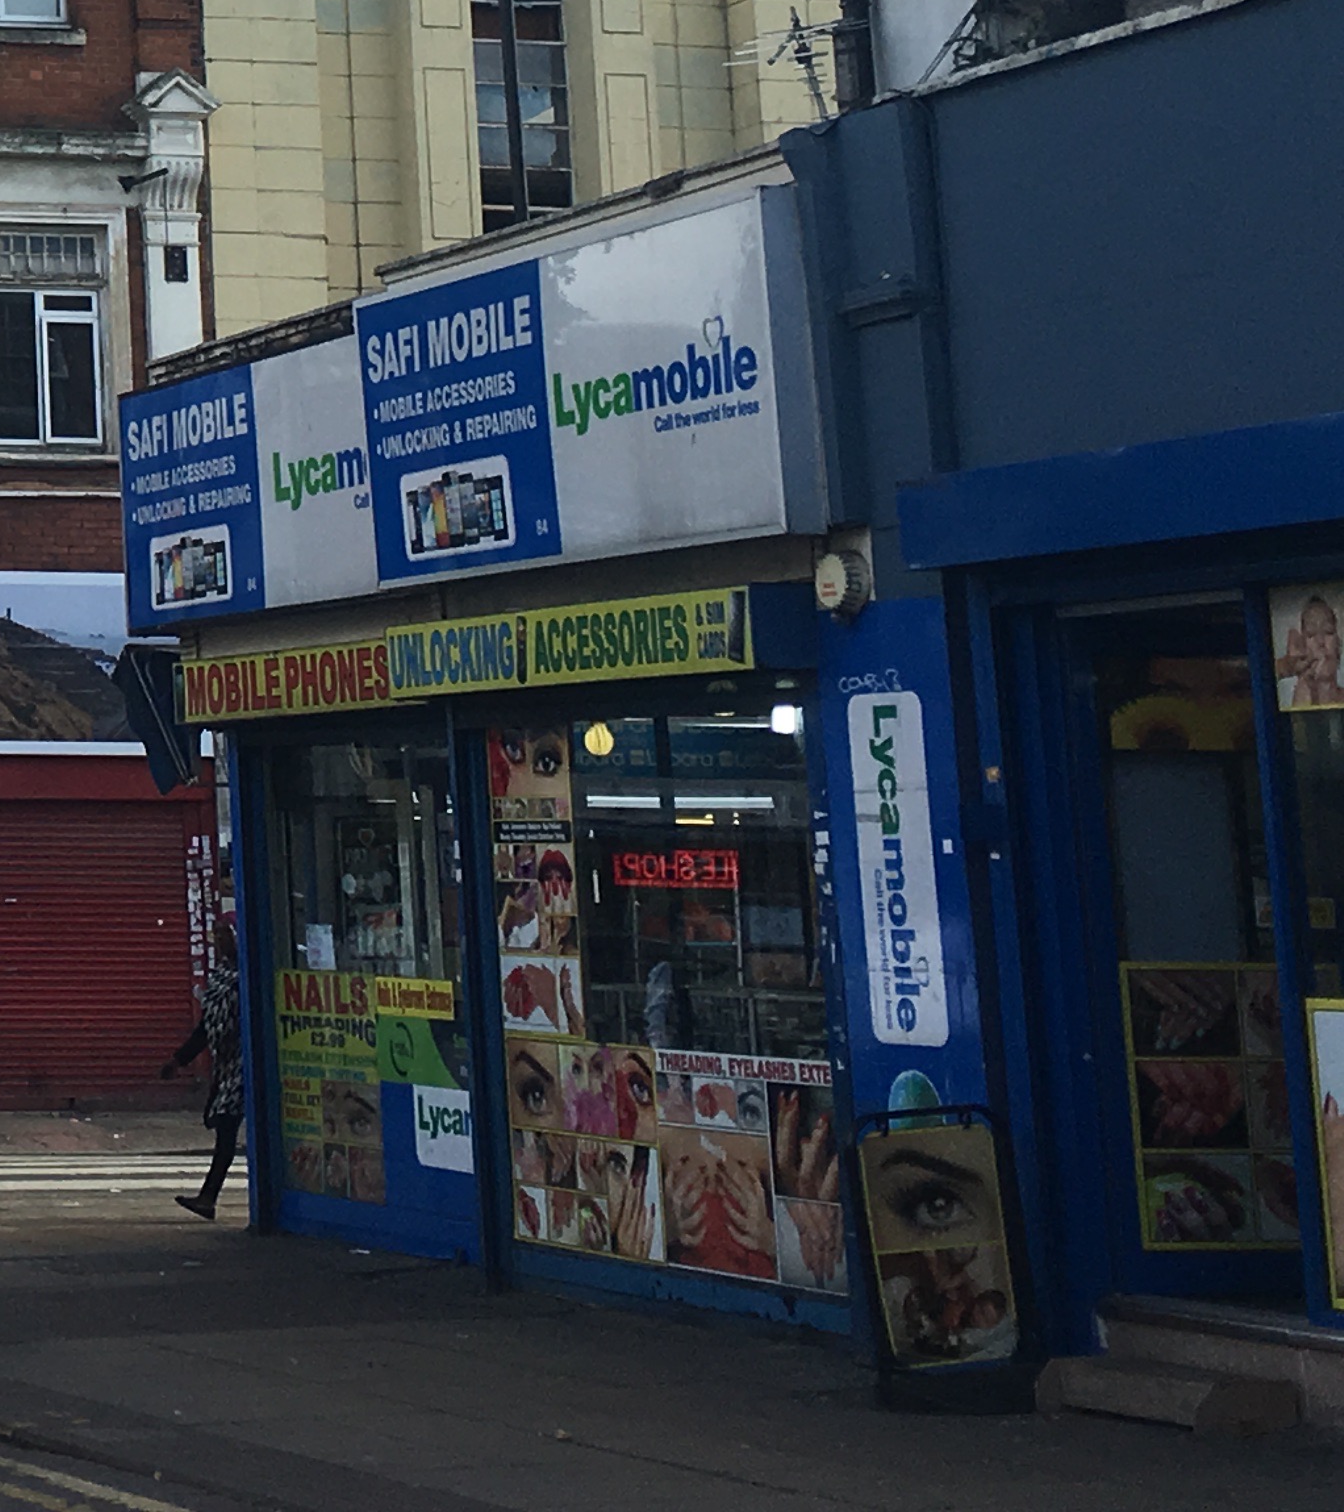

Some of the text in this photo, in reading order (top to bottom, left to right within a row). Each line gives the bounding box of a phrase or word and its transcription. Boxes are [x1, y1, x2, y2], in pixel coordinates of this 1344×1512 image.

[367, 294, 533, 384] SAFI MOBILE
[379, 370, 516, 424] MOBILE ACCESSORIES
[553, 335, 758, 436] Lycamobile
[127, 392, 249, 462] SAFI MOBILE
[382, 404, 538, 460] UNLOCKING & REPAIRING
[654, 399, 760, 433] Call the world for less
[136, 454, 237, 495] MOBILE ACCESSORIES
[272, 446, 368, 511] Lycam
[137, 483, 252, 526] UNLOCKING & REPAIRING
[389, 604, 690, 691] UNLOCKING ACCESSORIES
[185, 644, 389, 717] MOBILE PHONES
[868, 704, 921, 1034] Lycamobile
[283, 972, 369, 1016] NAILS
[280, 1014, 377, 1049] THREADING
[659, 1052, 832, 1085] THREADING, EYELASHES EXTE
